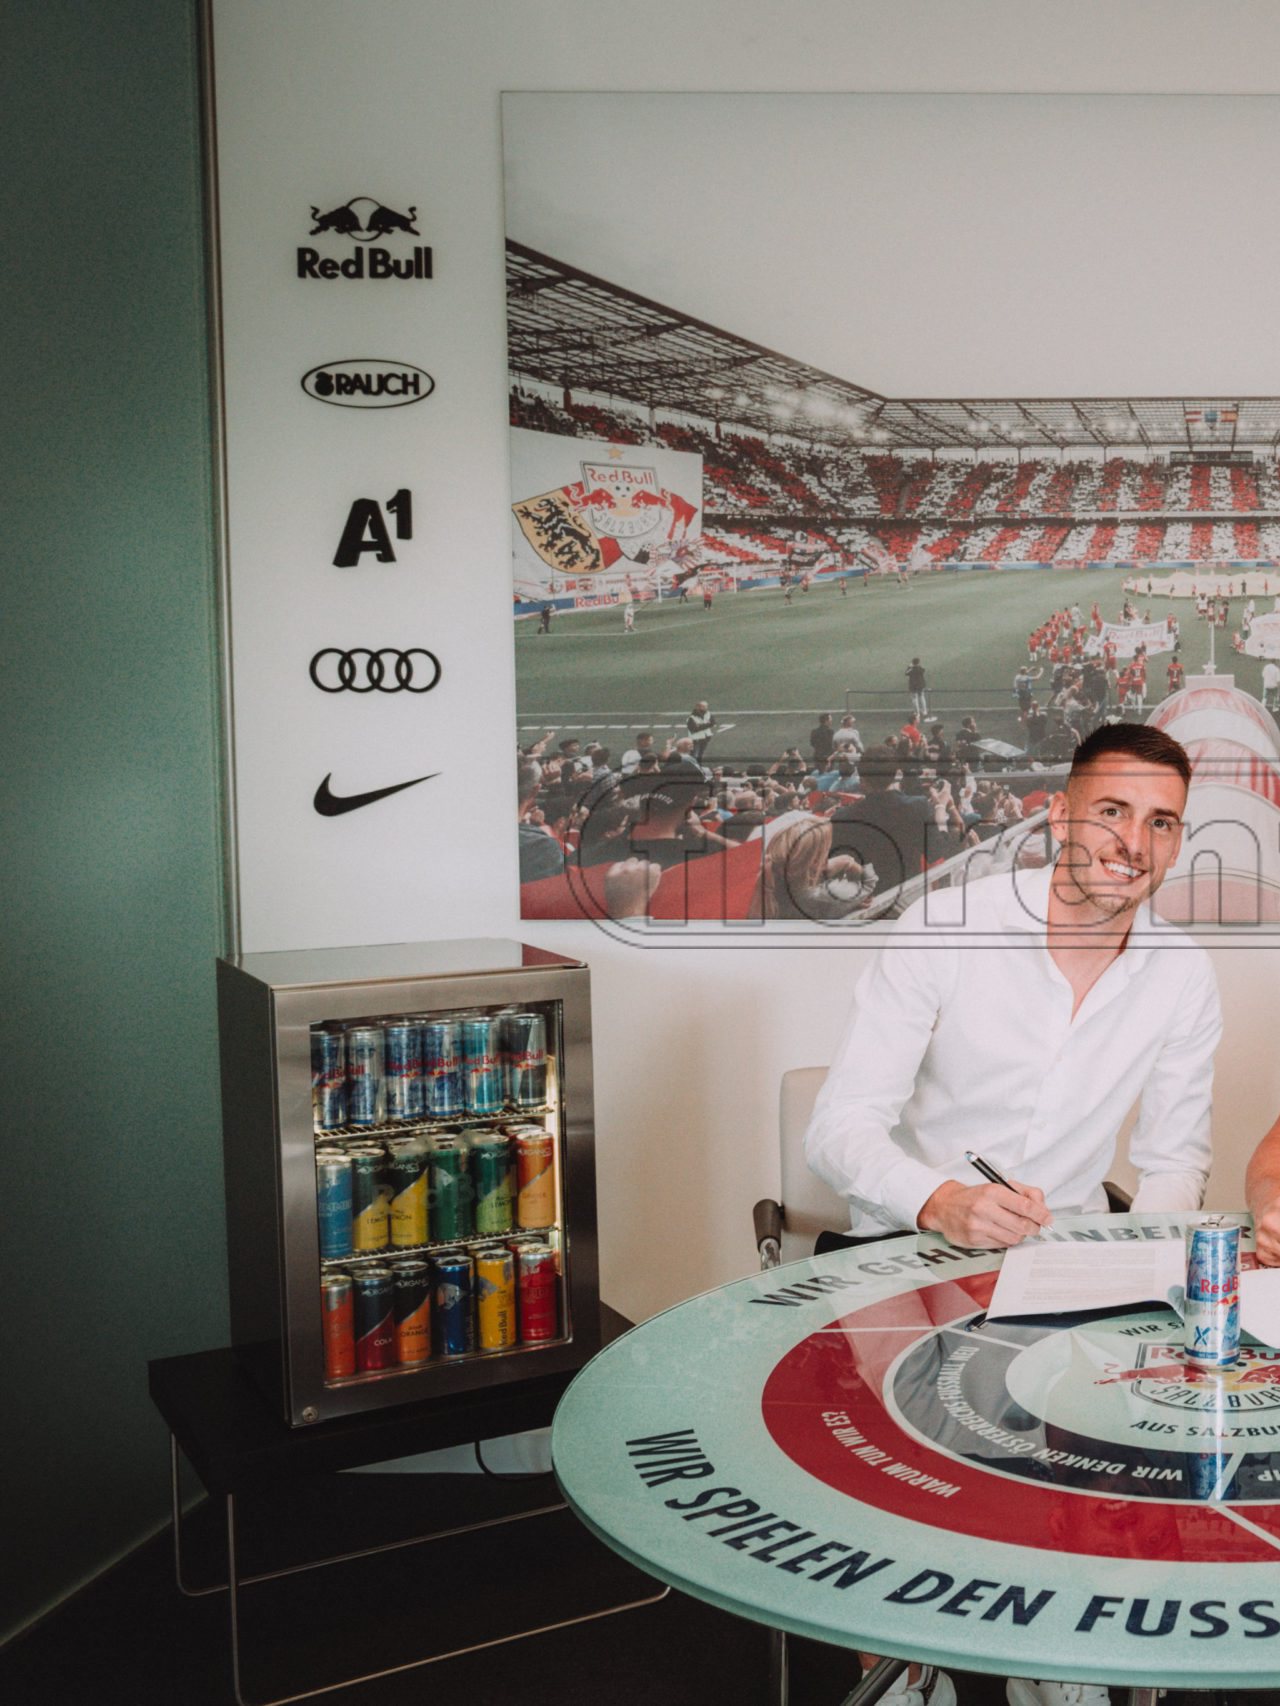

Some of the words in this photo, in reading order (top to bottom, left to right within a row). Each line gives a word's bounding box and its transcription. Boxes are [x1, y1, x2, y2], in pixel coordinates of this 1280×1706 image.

[297, 246, 364, 279] Red
[368, 246, 433, 279] Bull
[335, 373, 420, 396] RAUCH
[622, 470, 653, 485] Bull
[332, 488, 413, 568] A1
[749, 1274, 861, 1307] WIR
[858, 1246, 1008, 1276] GEHE
[1201, 1278, 1231, 1294] Red
[1118, 1324, 1163, 1337] WIR
[947, 1345, 980, 1361] NEU
[1150, 1346, 1184, 1360] Re
[936, 1362, 966, 1400] FUSSBALL
[821, 1411, 851, 1427] ES?
[943, 1401, 1037, 1454] ÖSTERREICHS
[1131, 1420, 1178, 1436] AUS
[832, 1426, 867, 1447] WIR
[625, 1428, 715, 1488] WIR
[851, 1445, 893, 1466] TUN
[1032, 1448, 1127, 1475] DENKEN
[881, 1462, 962, 1498] WARUM
[1131, 1465, 1183, 1482] WIR
[664, 1486, 896, 1590] SPIELEN
[882, 1569, 1057, 1626] DEN
